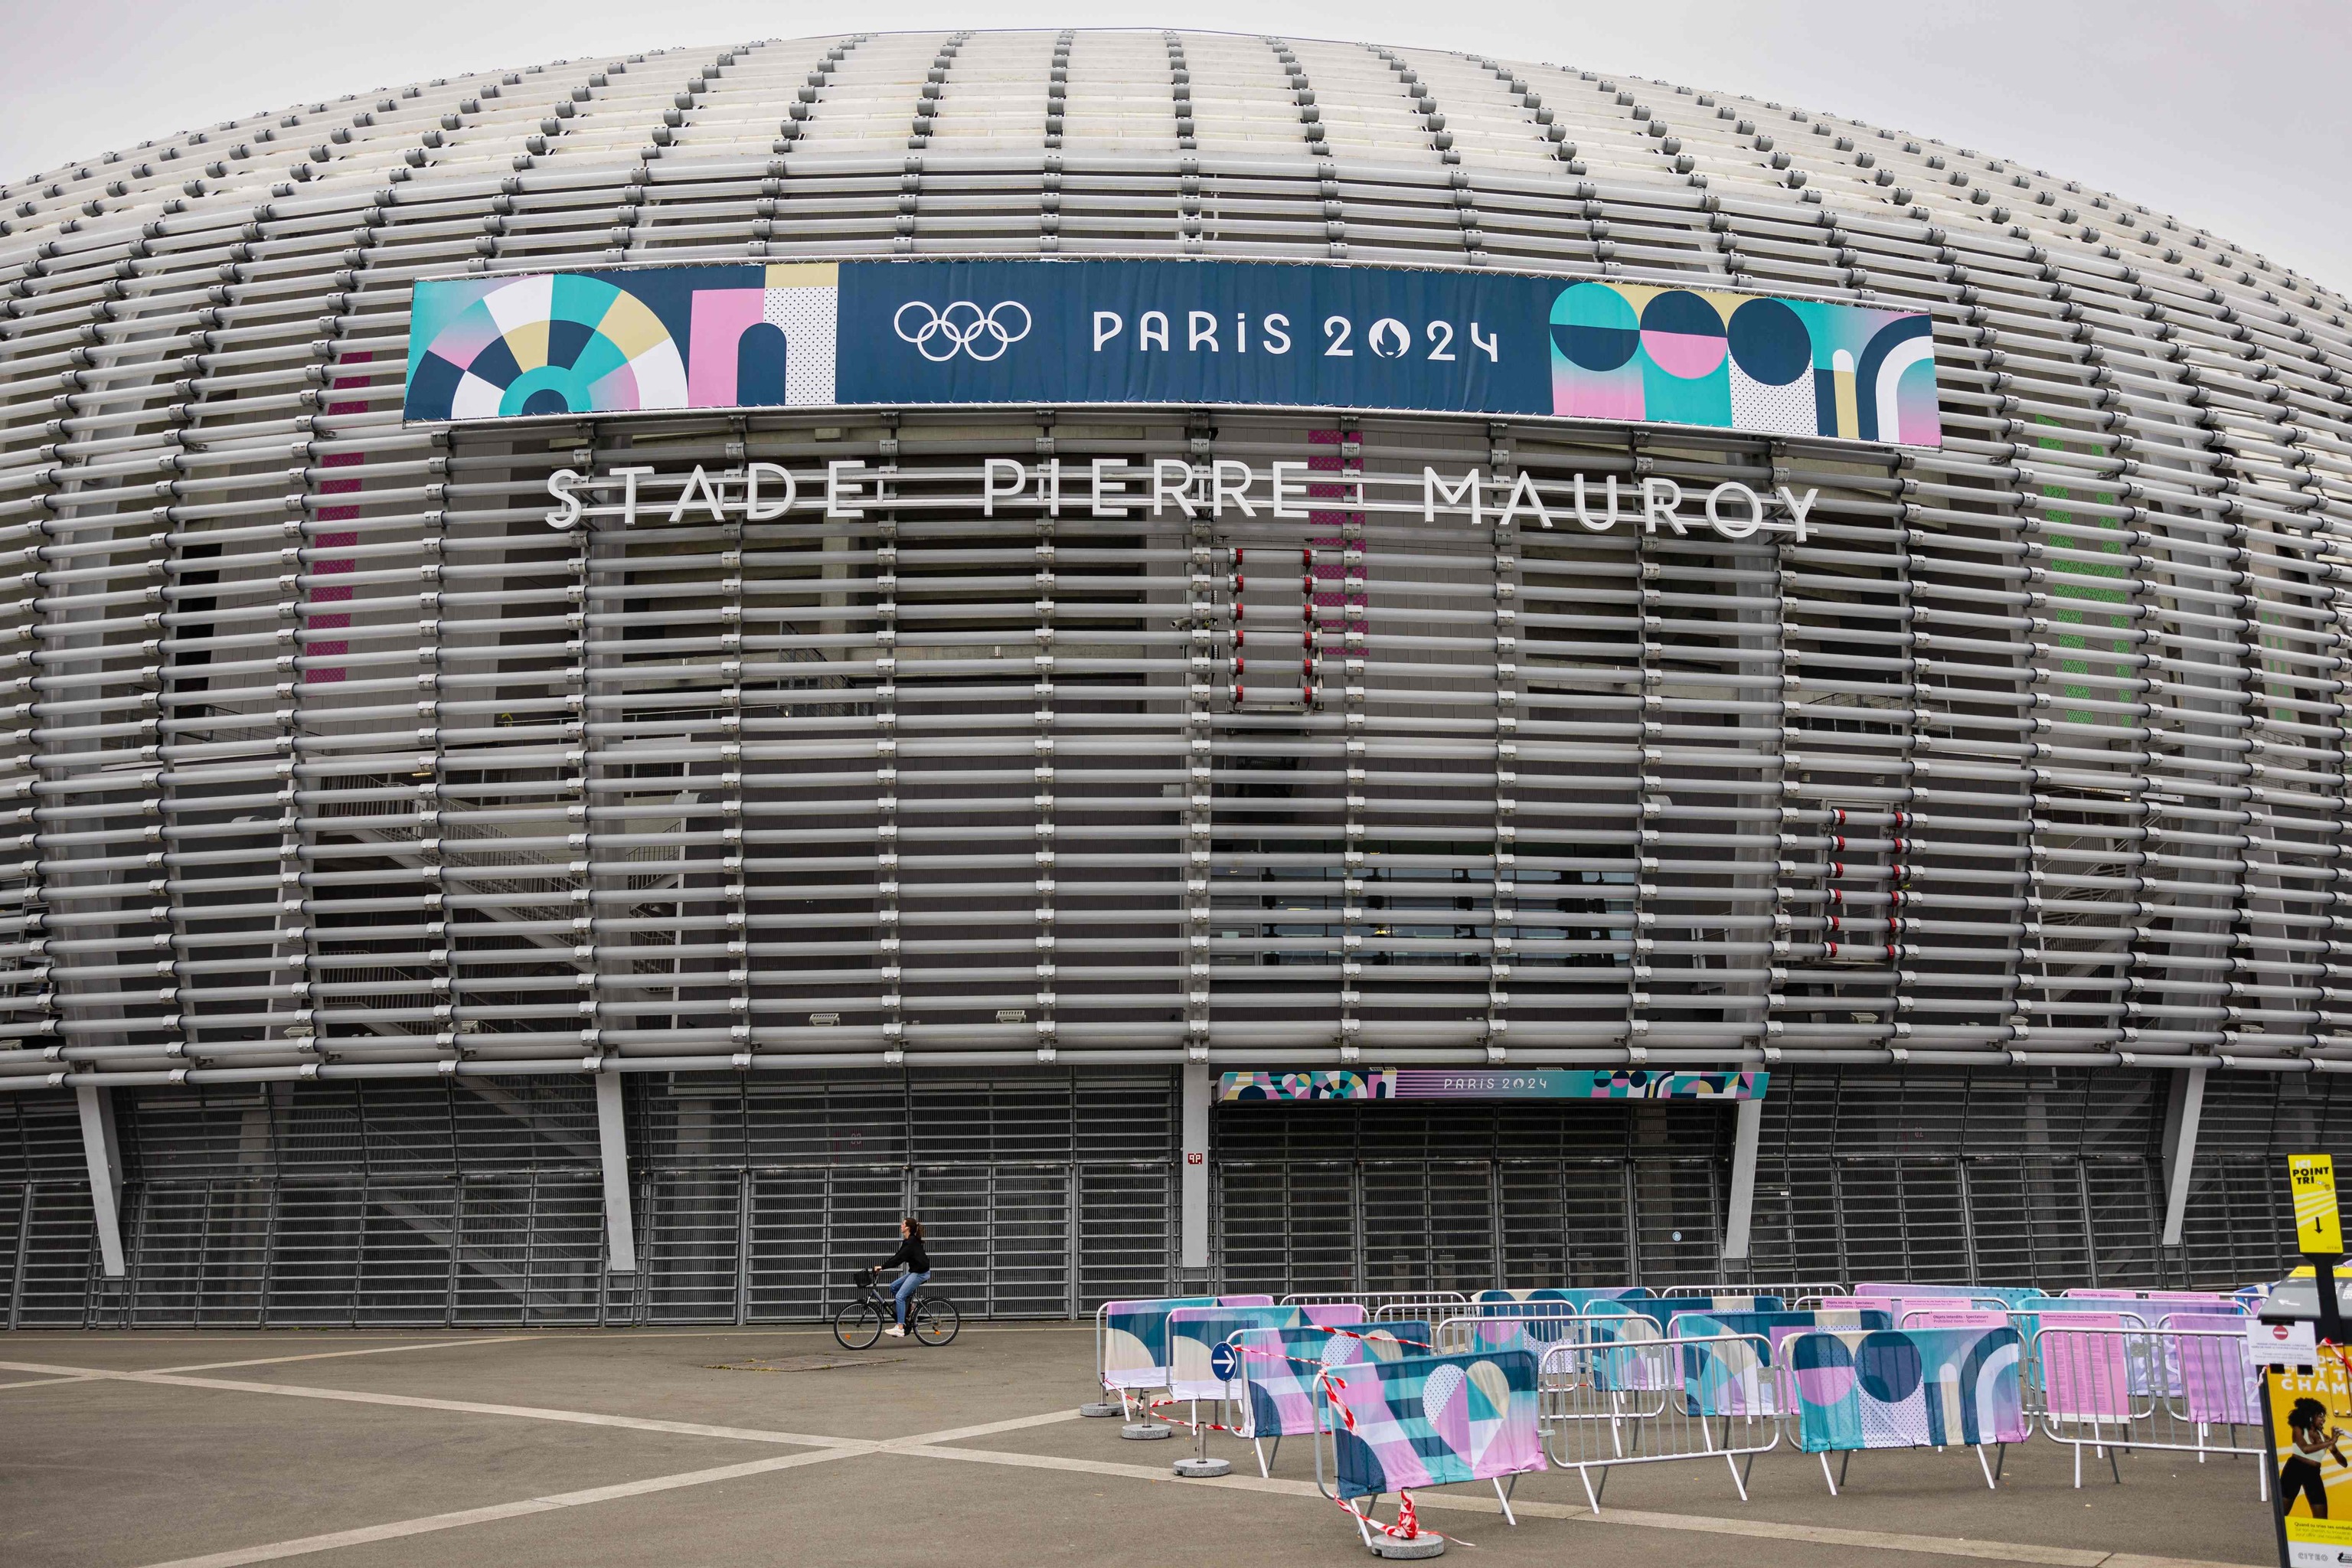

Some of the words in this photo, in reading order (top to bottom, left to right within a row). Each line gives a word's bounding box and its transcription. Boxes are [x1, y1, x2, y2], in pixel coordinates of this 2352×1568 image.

[1324, 315, 1498, 363] 2024
[544, 460, 866, 530] STADE
[984, 459, 1309, 518] PIERRE
[1424, 466, 1819, 543] MAUROY
[2292, 1166, 2330, 1178] POINT
[2296, 1176, 2314, 1184] TRI
[2298, 1552, 2328, 1561] CITEO
